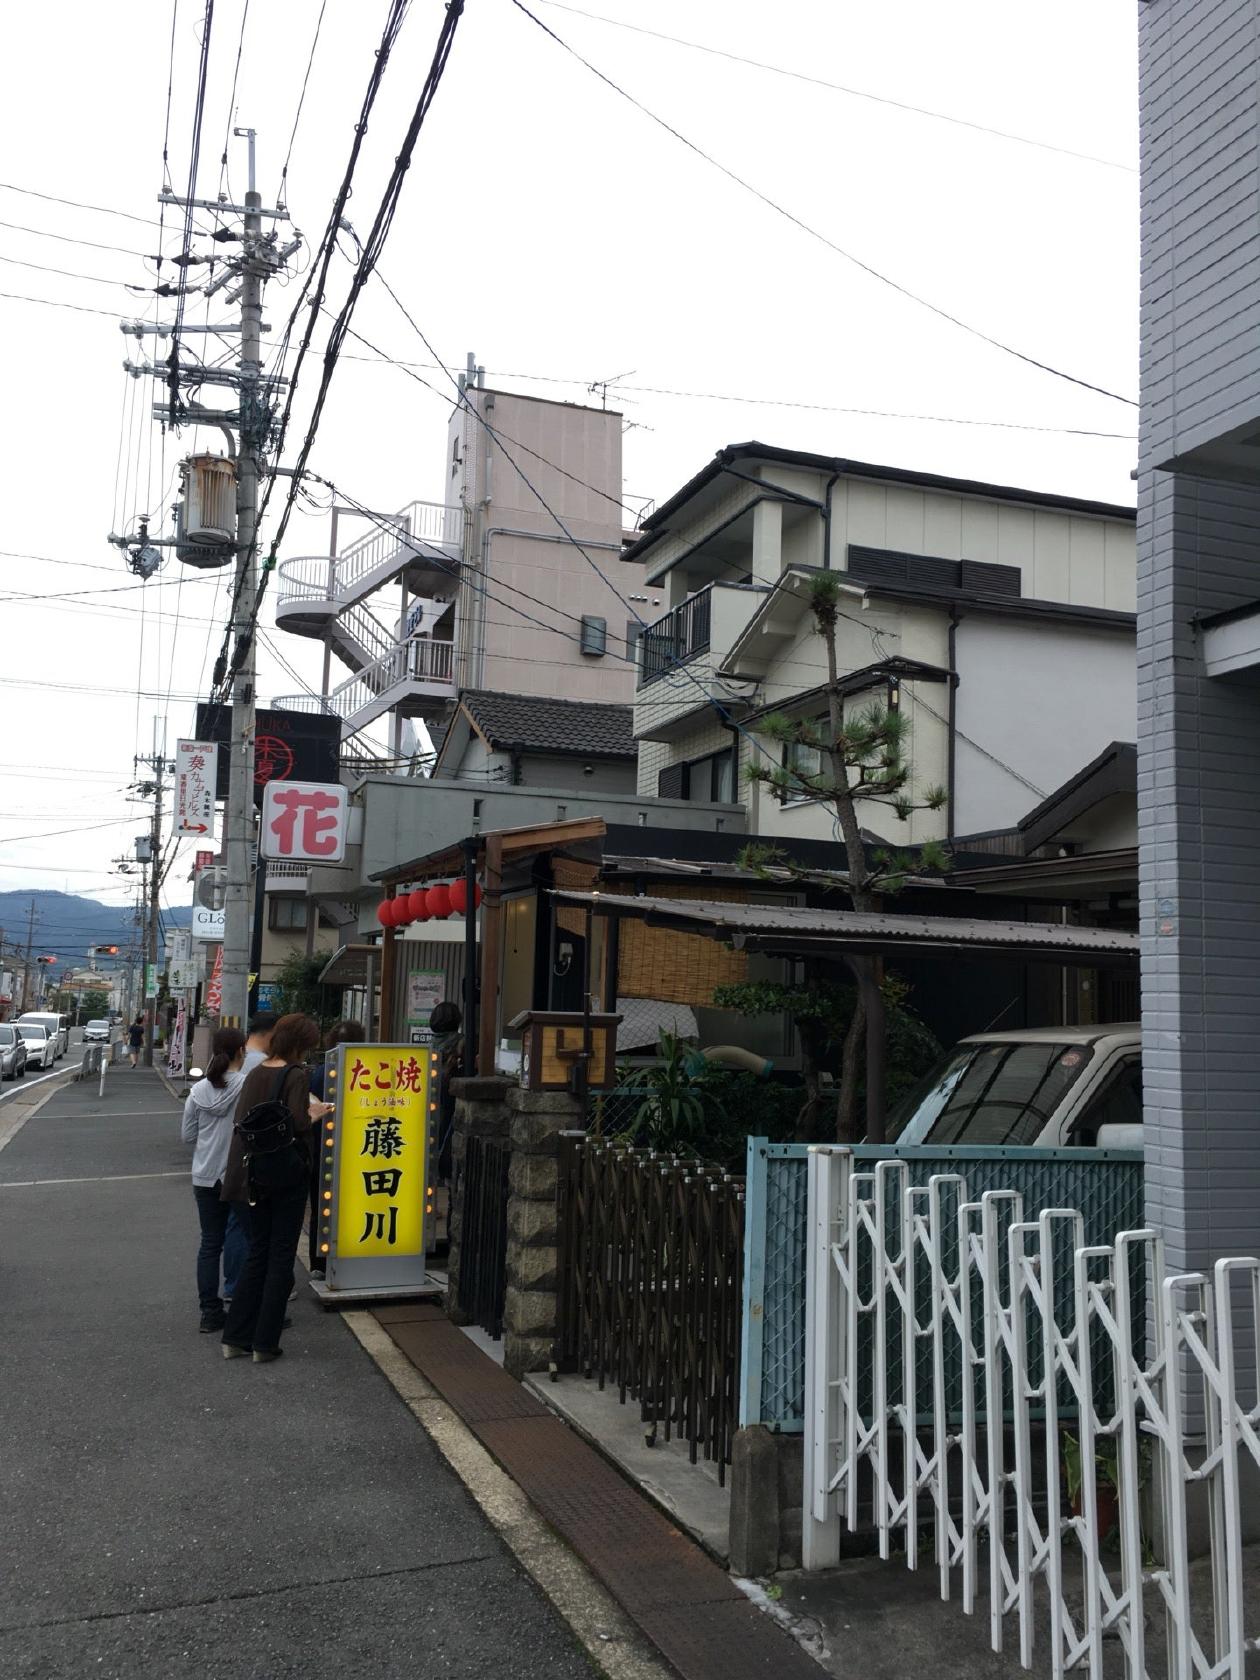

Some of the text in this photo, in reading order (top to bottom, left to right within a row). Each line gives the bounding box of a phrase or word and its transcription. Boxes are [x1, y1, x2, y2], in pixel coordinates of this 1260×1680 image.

[271, 789, 340, 855] 花
[349, 1056, 422, 1094] たこ焼
[358, 1116, 407, 1246] 藤田川
